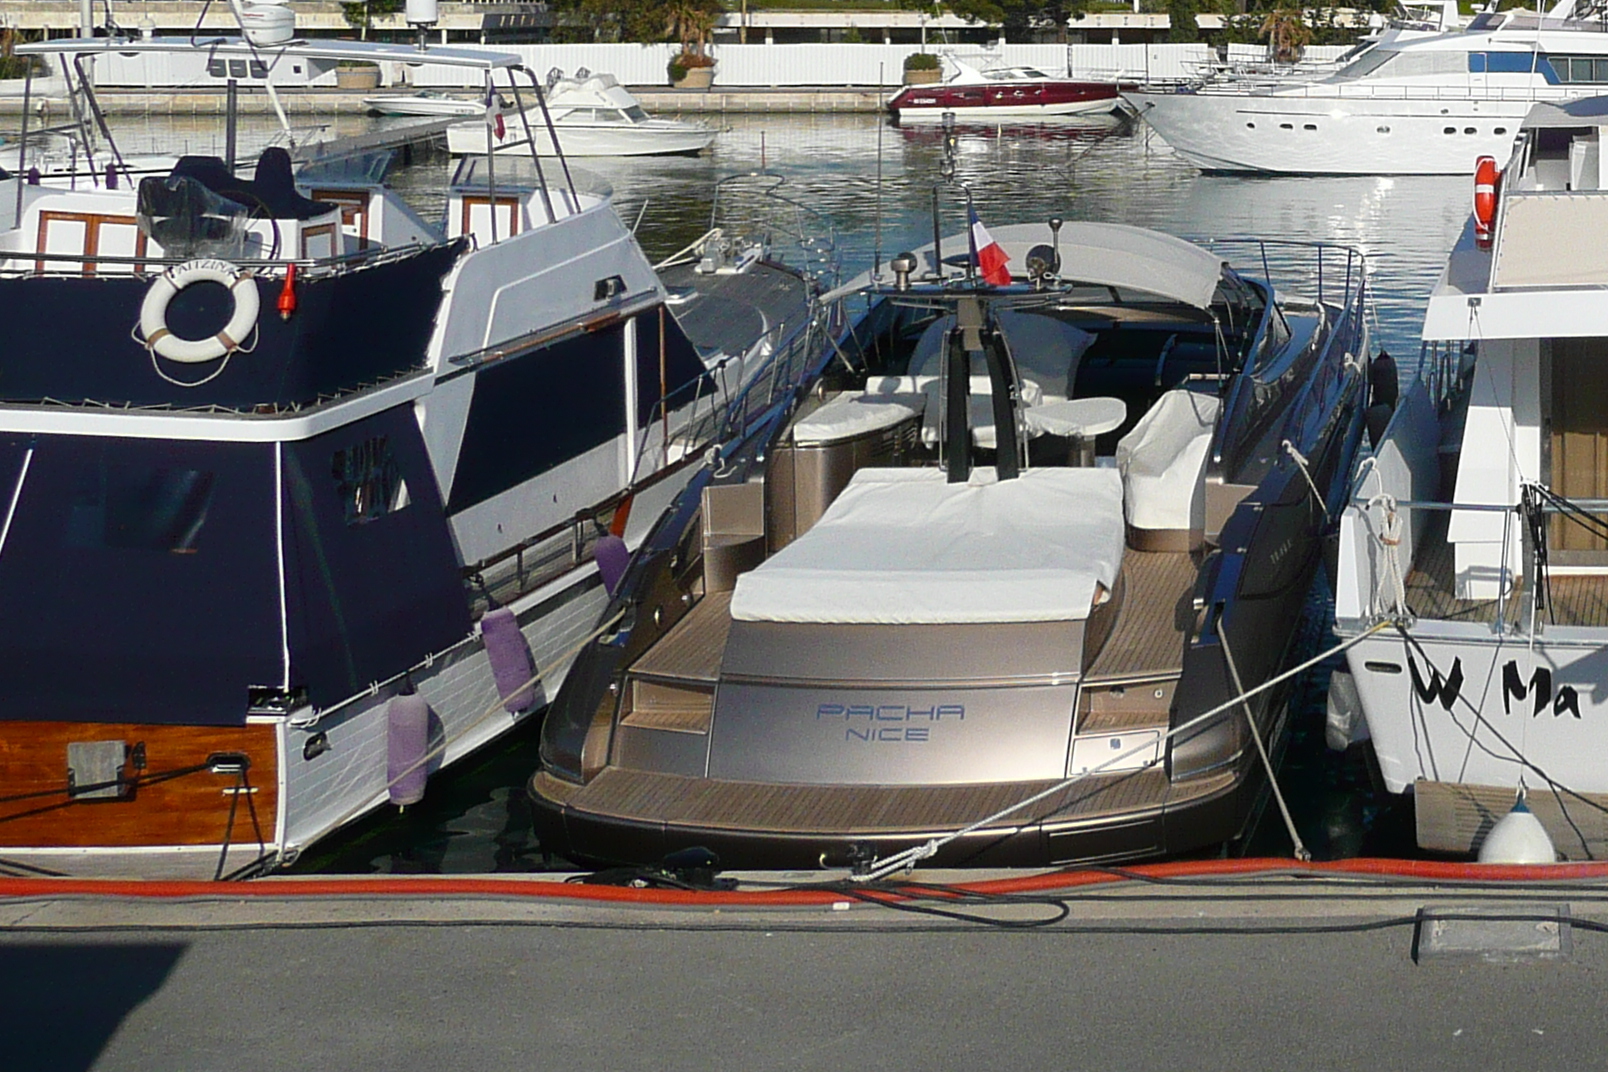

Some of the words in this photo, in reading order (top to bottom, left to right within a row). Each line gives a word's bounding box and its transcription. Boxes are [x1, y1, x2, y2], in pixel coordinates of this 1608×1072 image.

[1407, 656, 1464, 712] W
[816, 703, 966, 721] PACHA
[845, 727, 930, 742] NICE
